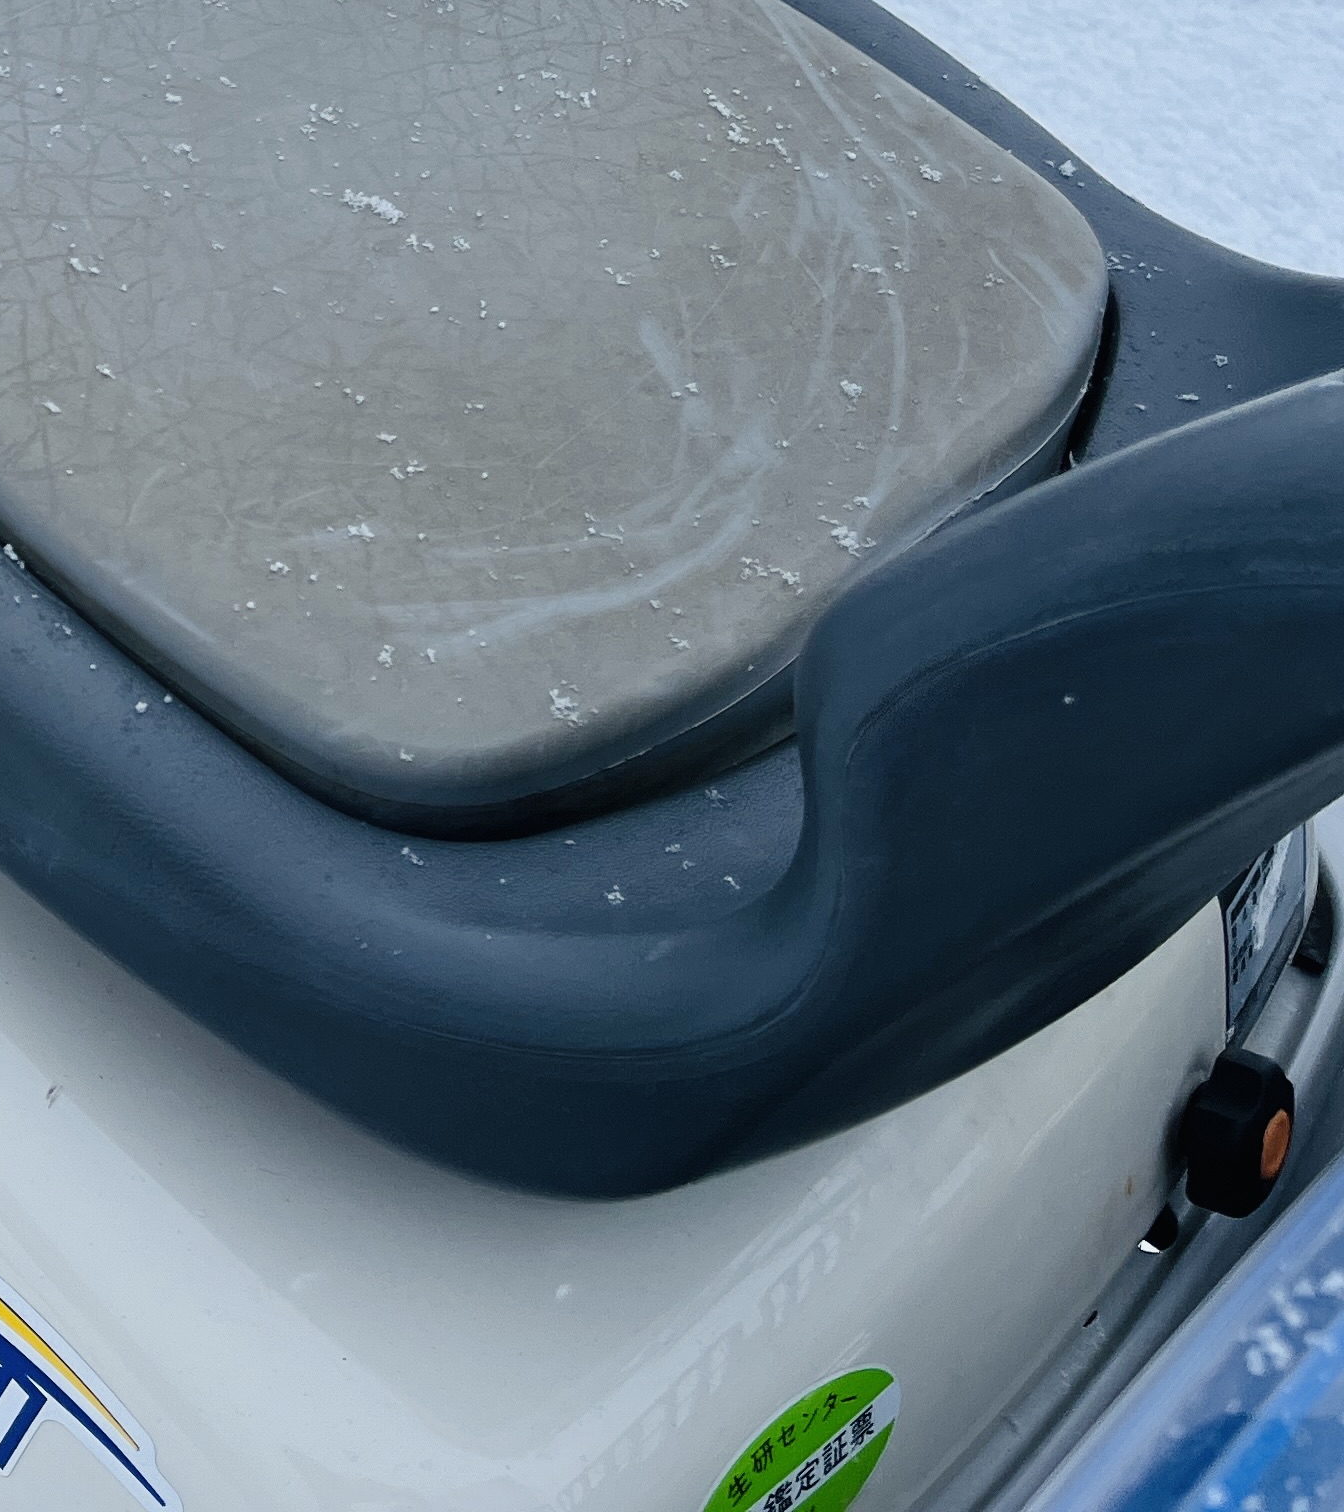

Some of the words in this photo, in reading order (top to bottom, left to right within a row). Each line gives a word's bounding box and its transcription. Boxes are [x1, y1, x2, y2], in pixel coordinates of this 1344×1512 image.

[728, 1392, 859, 1508] 生研センター
[763, 1404, 874, 1512] 鑑定証票
